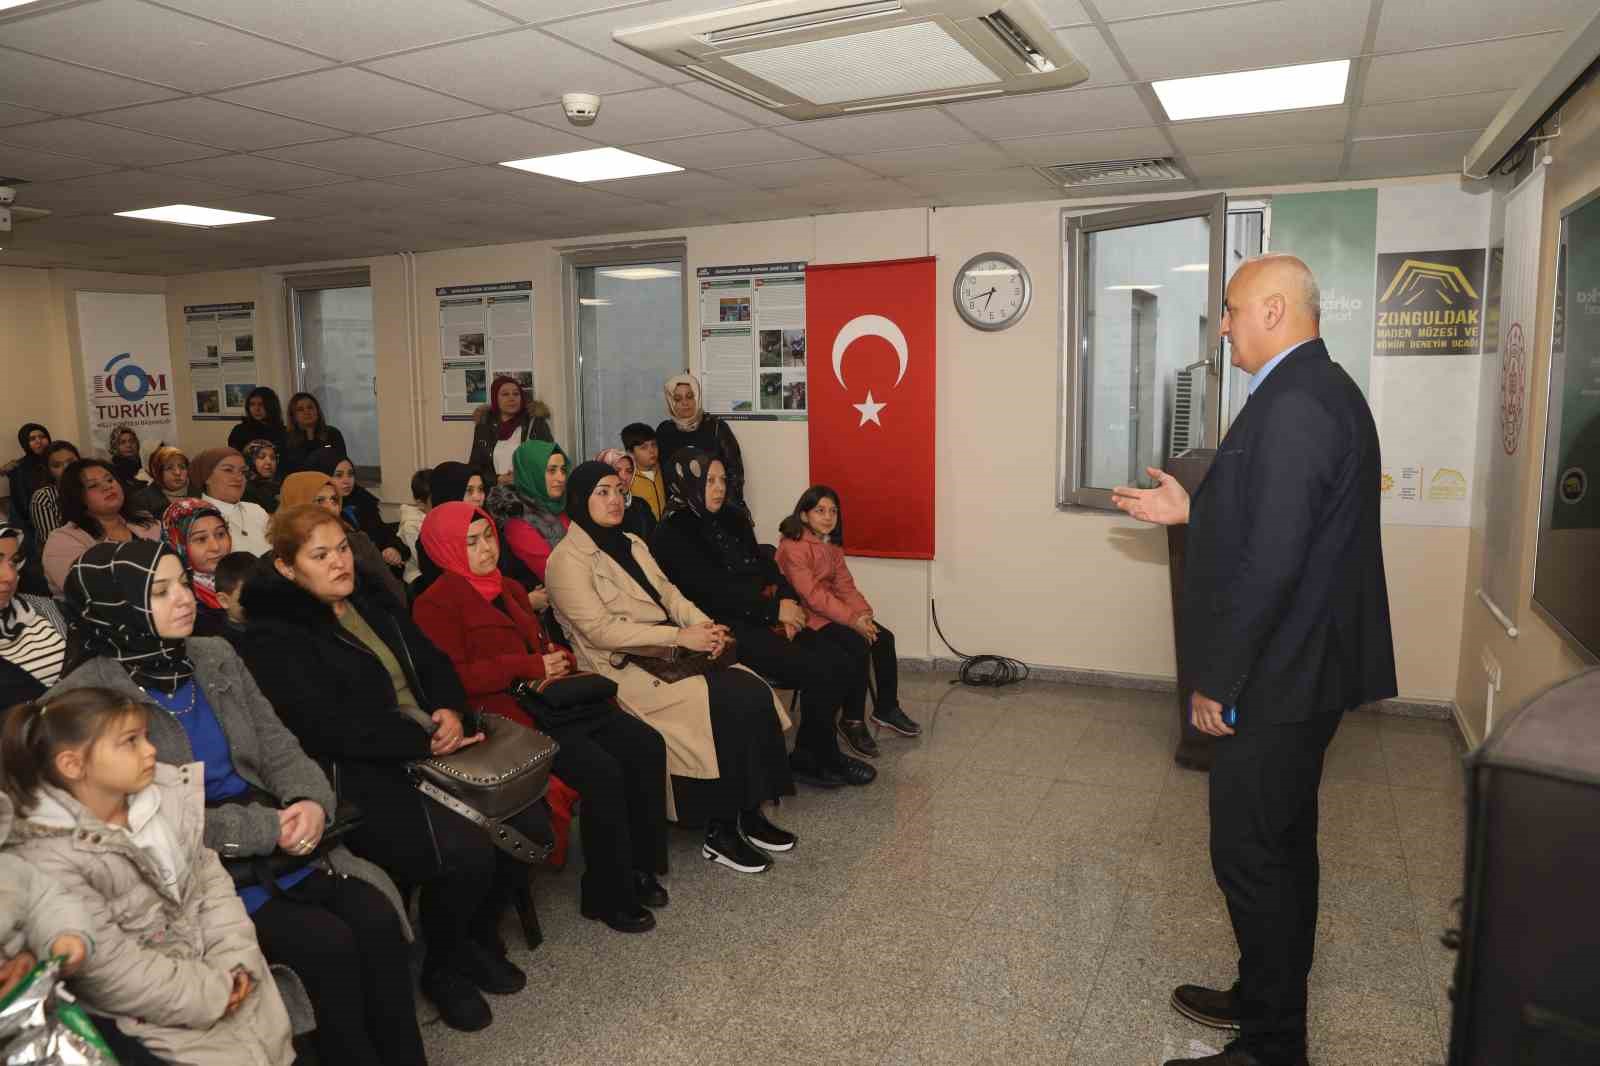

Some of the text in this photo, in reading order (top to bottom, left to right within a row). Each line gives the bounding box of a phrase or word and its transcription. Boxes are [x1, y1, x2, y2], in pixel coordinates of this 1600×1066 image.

[1377, 310, 1479, 326] ZONGULDAK
[1376, 326, 1479, 338] MADEN MÜZESİ VE
[95, 401, 171, 419] TÜRKİYE
